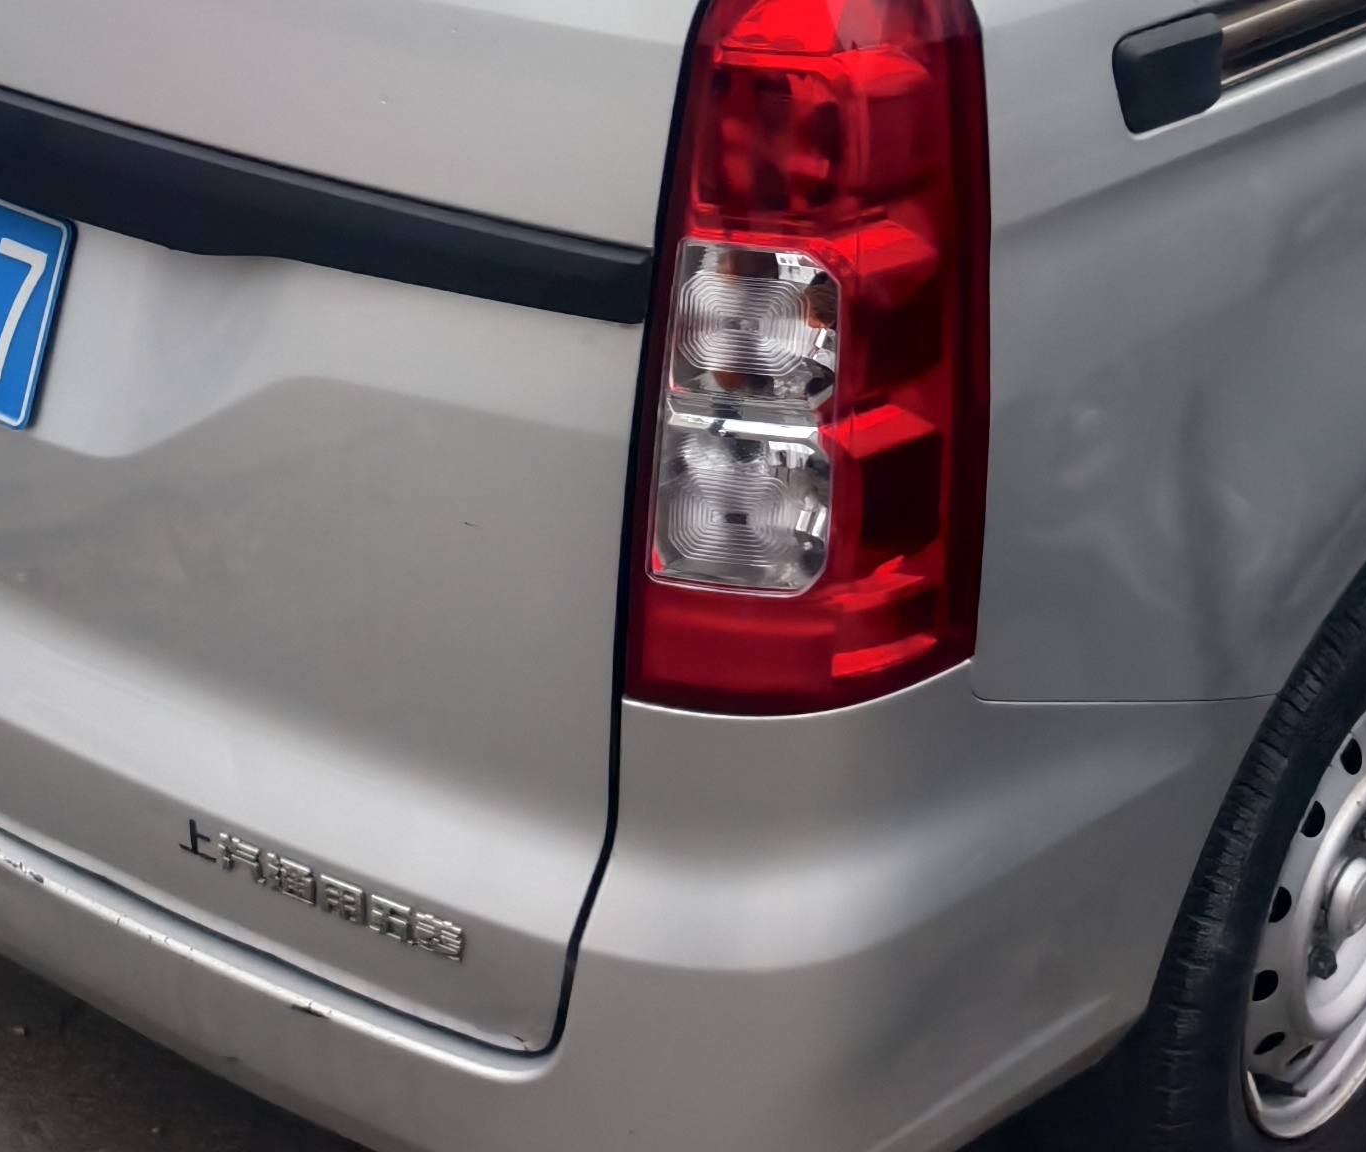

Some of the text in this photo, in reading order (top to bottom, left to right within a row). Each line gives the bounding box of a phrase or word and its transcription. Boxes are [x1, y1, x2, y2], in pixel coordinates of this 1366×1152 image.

[178, 818, 465, 963] 上汽通用五菱
